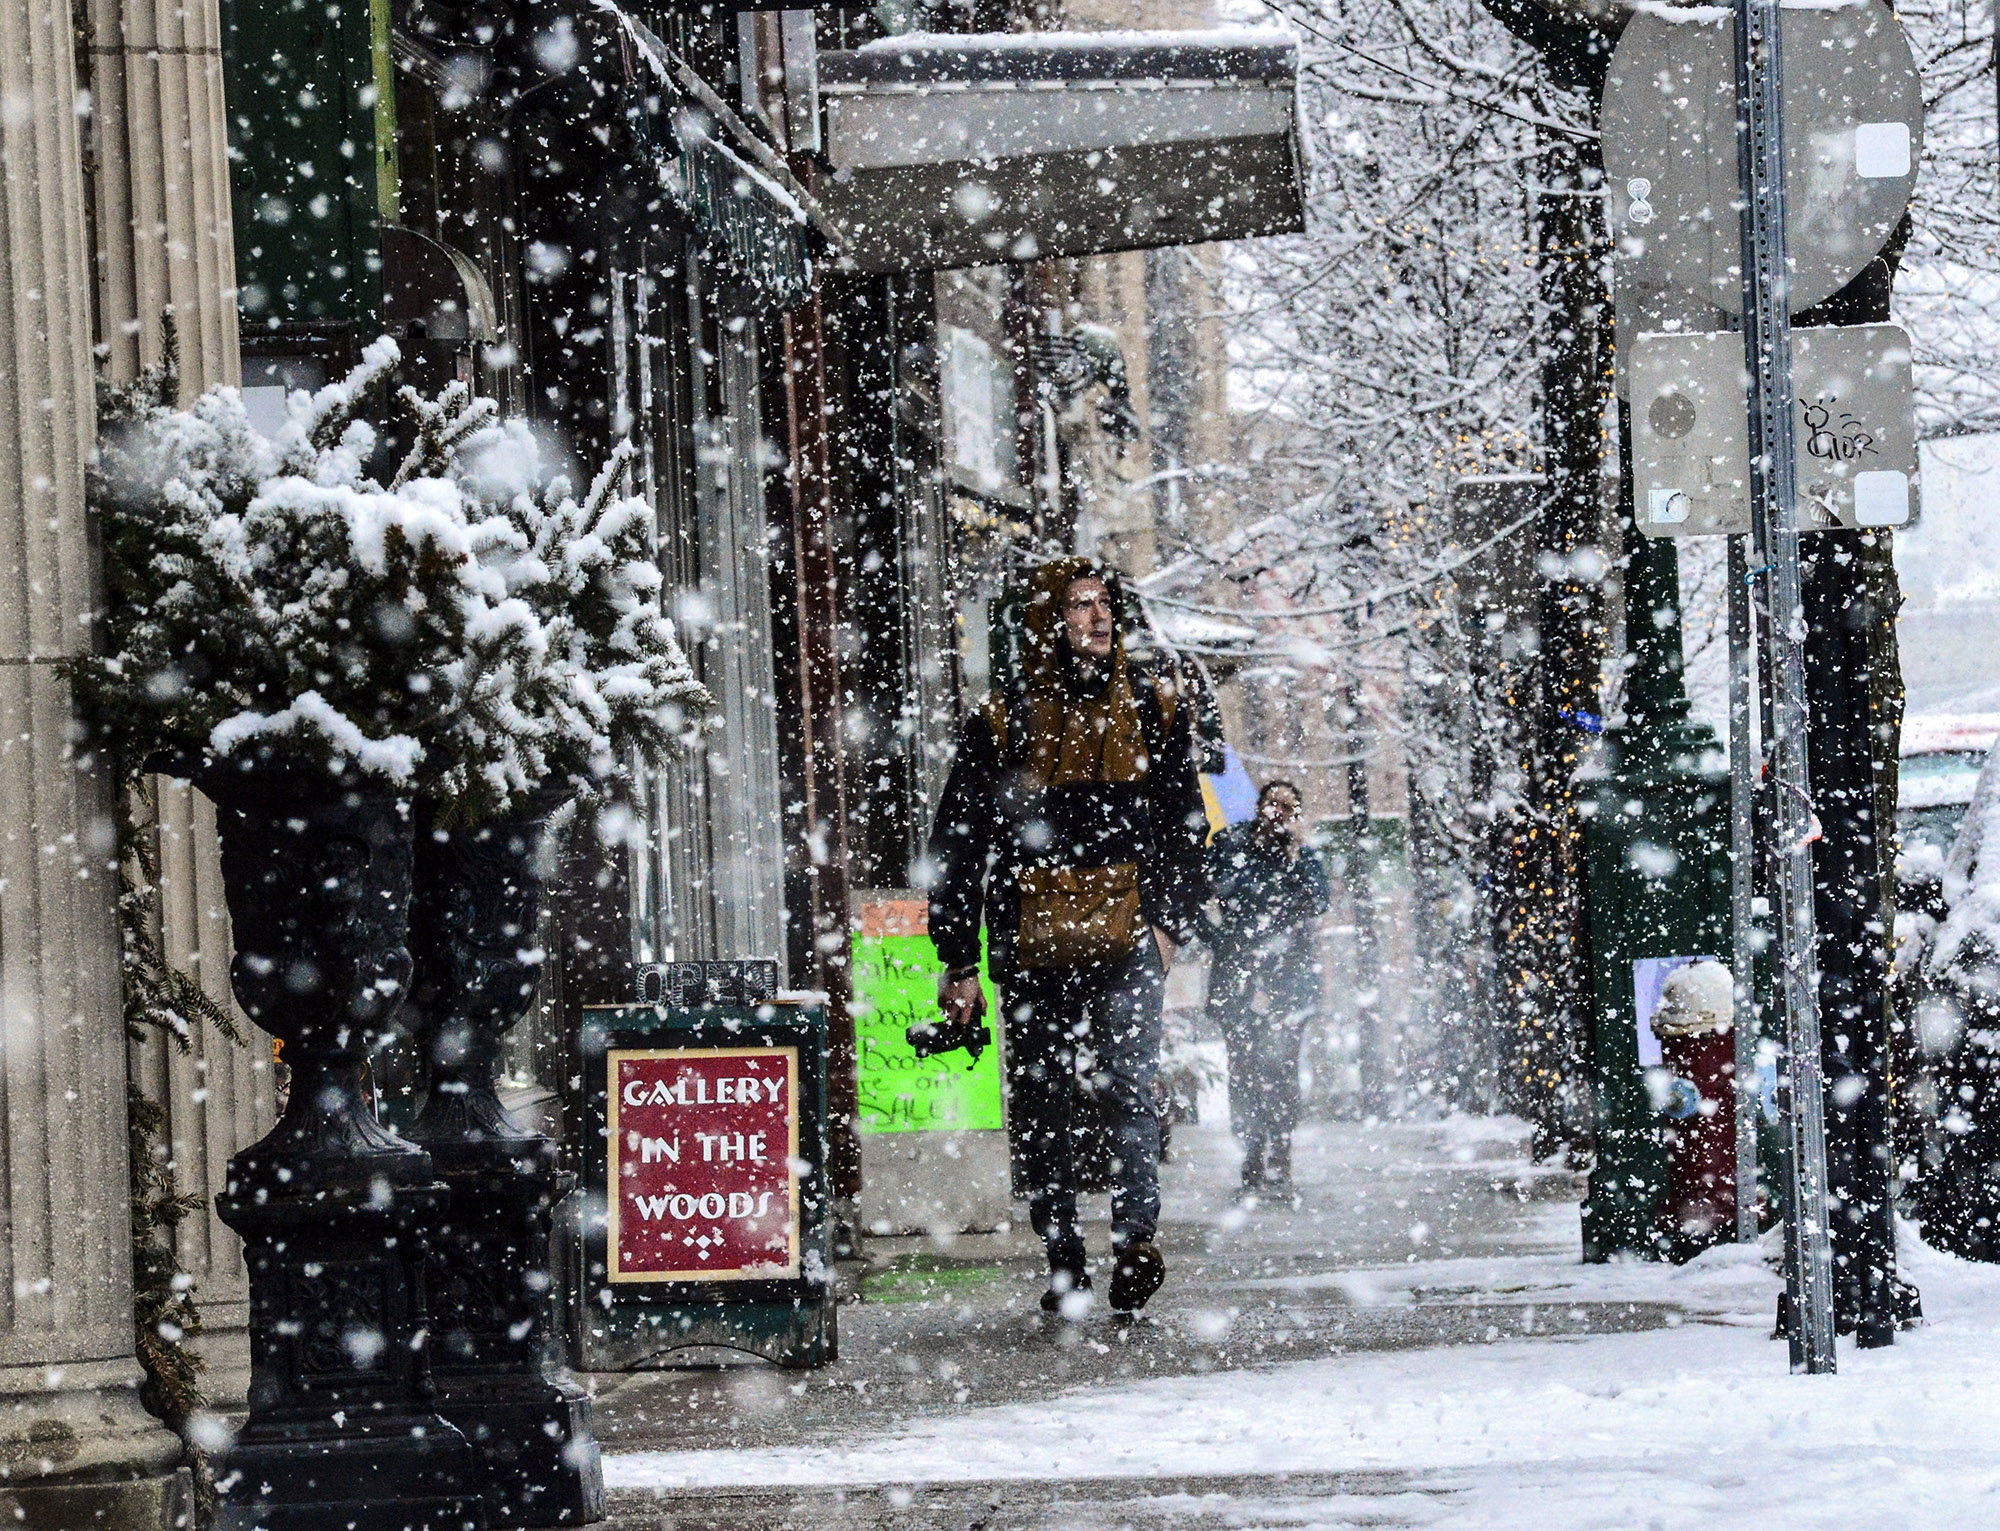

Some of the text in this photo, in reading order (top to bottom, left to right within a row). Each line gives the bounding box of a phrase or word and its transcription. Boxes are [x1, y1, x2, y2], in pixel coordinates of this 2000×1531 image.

[637, 961, 776, 1008] OPEN
[624, 1076, 785, 1107] GALLERY
[641, 1133, 769, 1164] IN THE
[635, 1191, 774, 1221] WOODS
